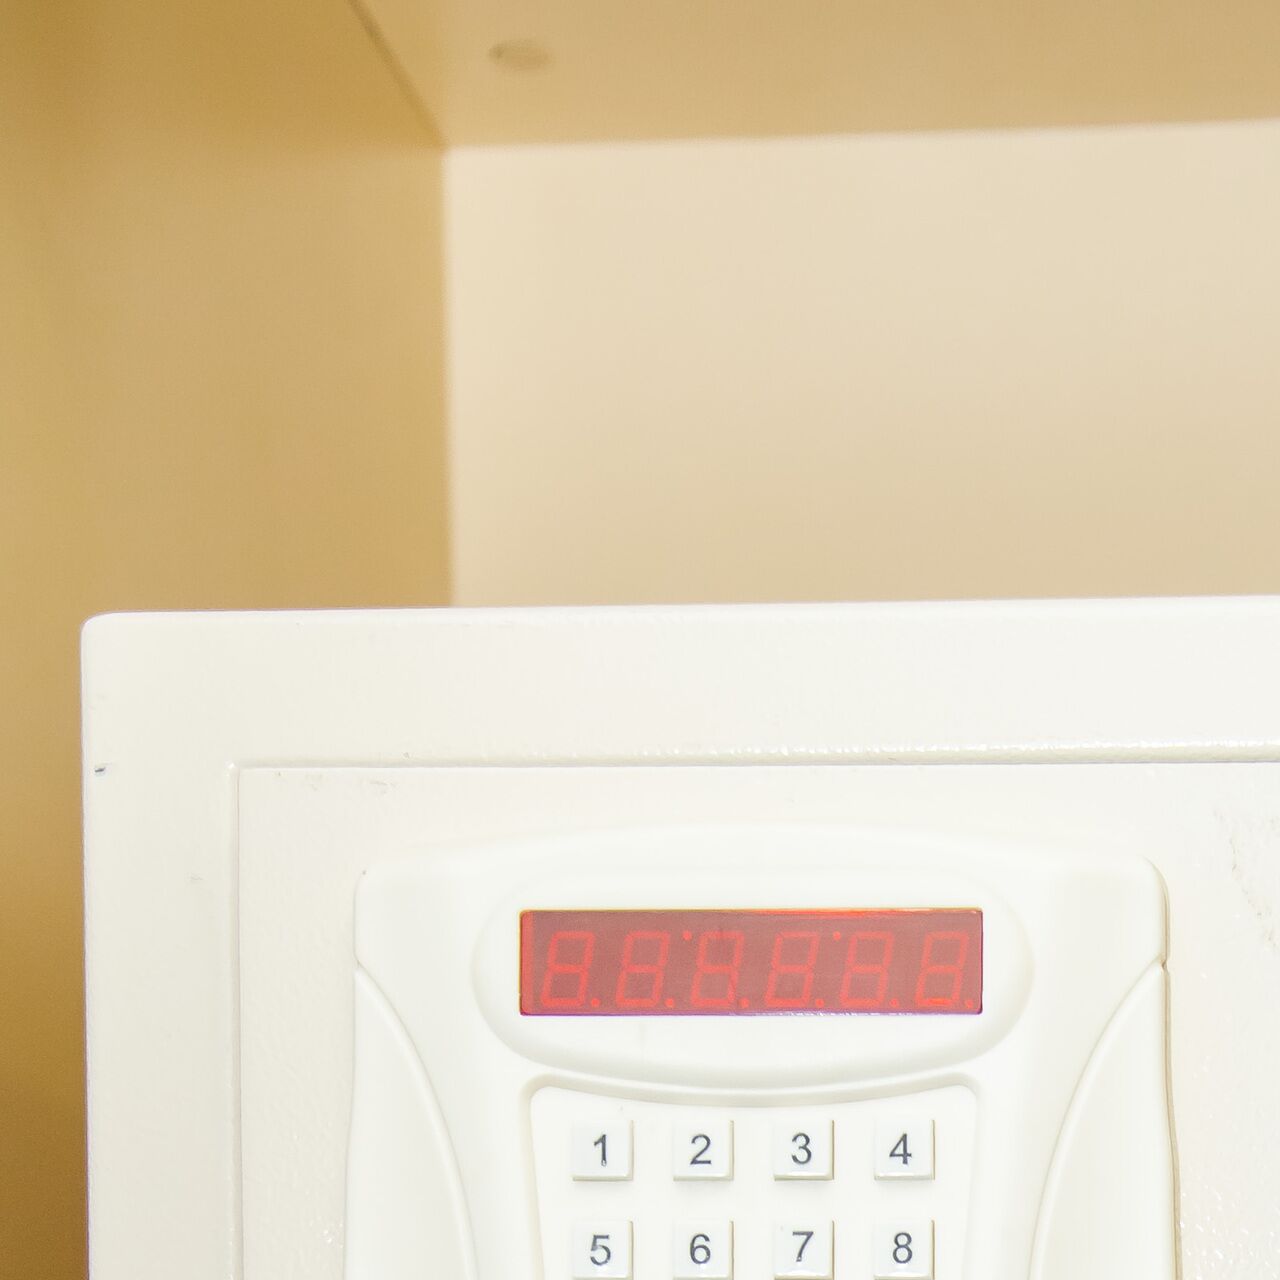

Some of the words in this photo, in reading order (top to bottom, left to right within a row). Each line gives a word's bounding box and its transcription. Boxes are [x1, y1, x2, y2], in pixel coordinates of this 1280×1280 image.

[593, 1134, 607, 1166] 1
[690, 1134, 712, 1165] 2
[791, 1132, 812, 1165] 3
[889, 1133, 912, 1165] 4
[590, 1234, 611, 1266] 5
[689, 1233, 711, 1265] 6
[792, 1231, 814, 1262] 7
[892, 1232, 913, 1264] 8
